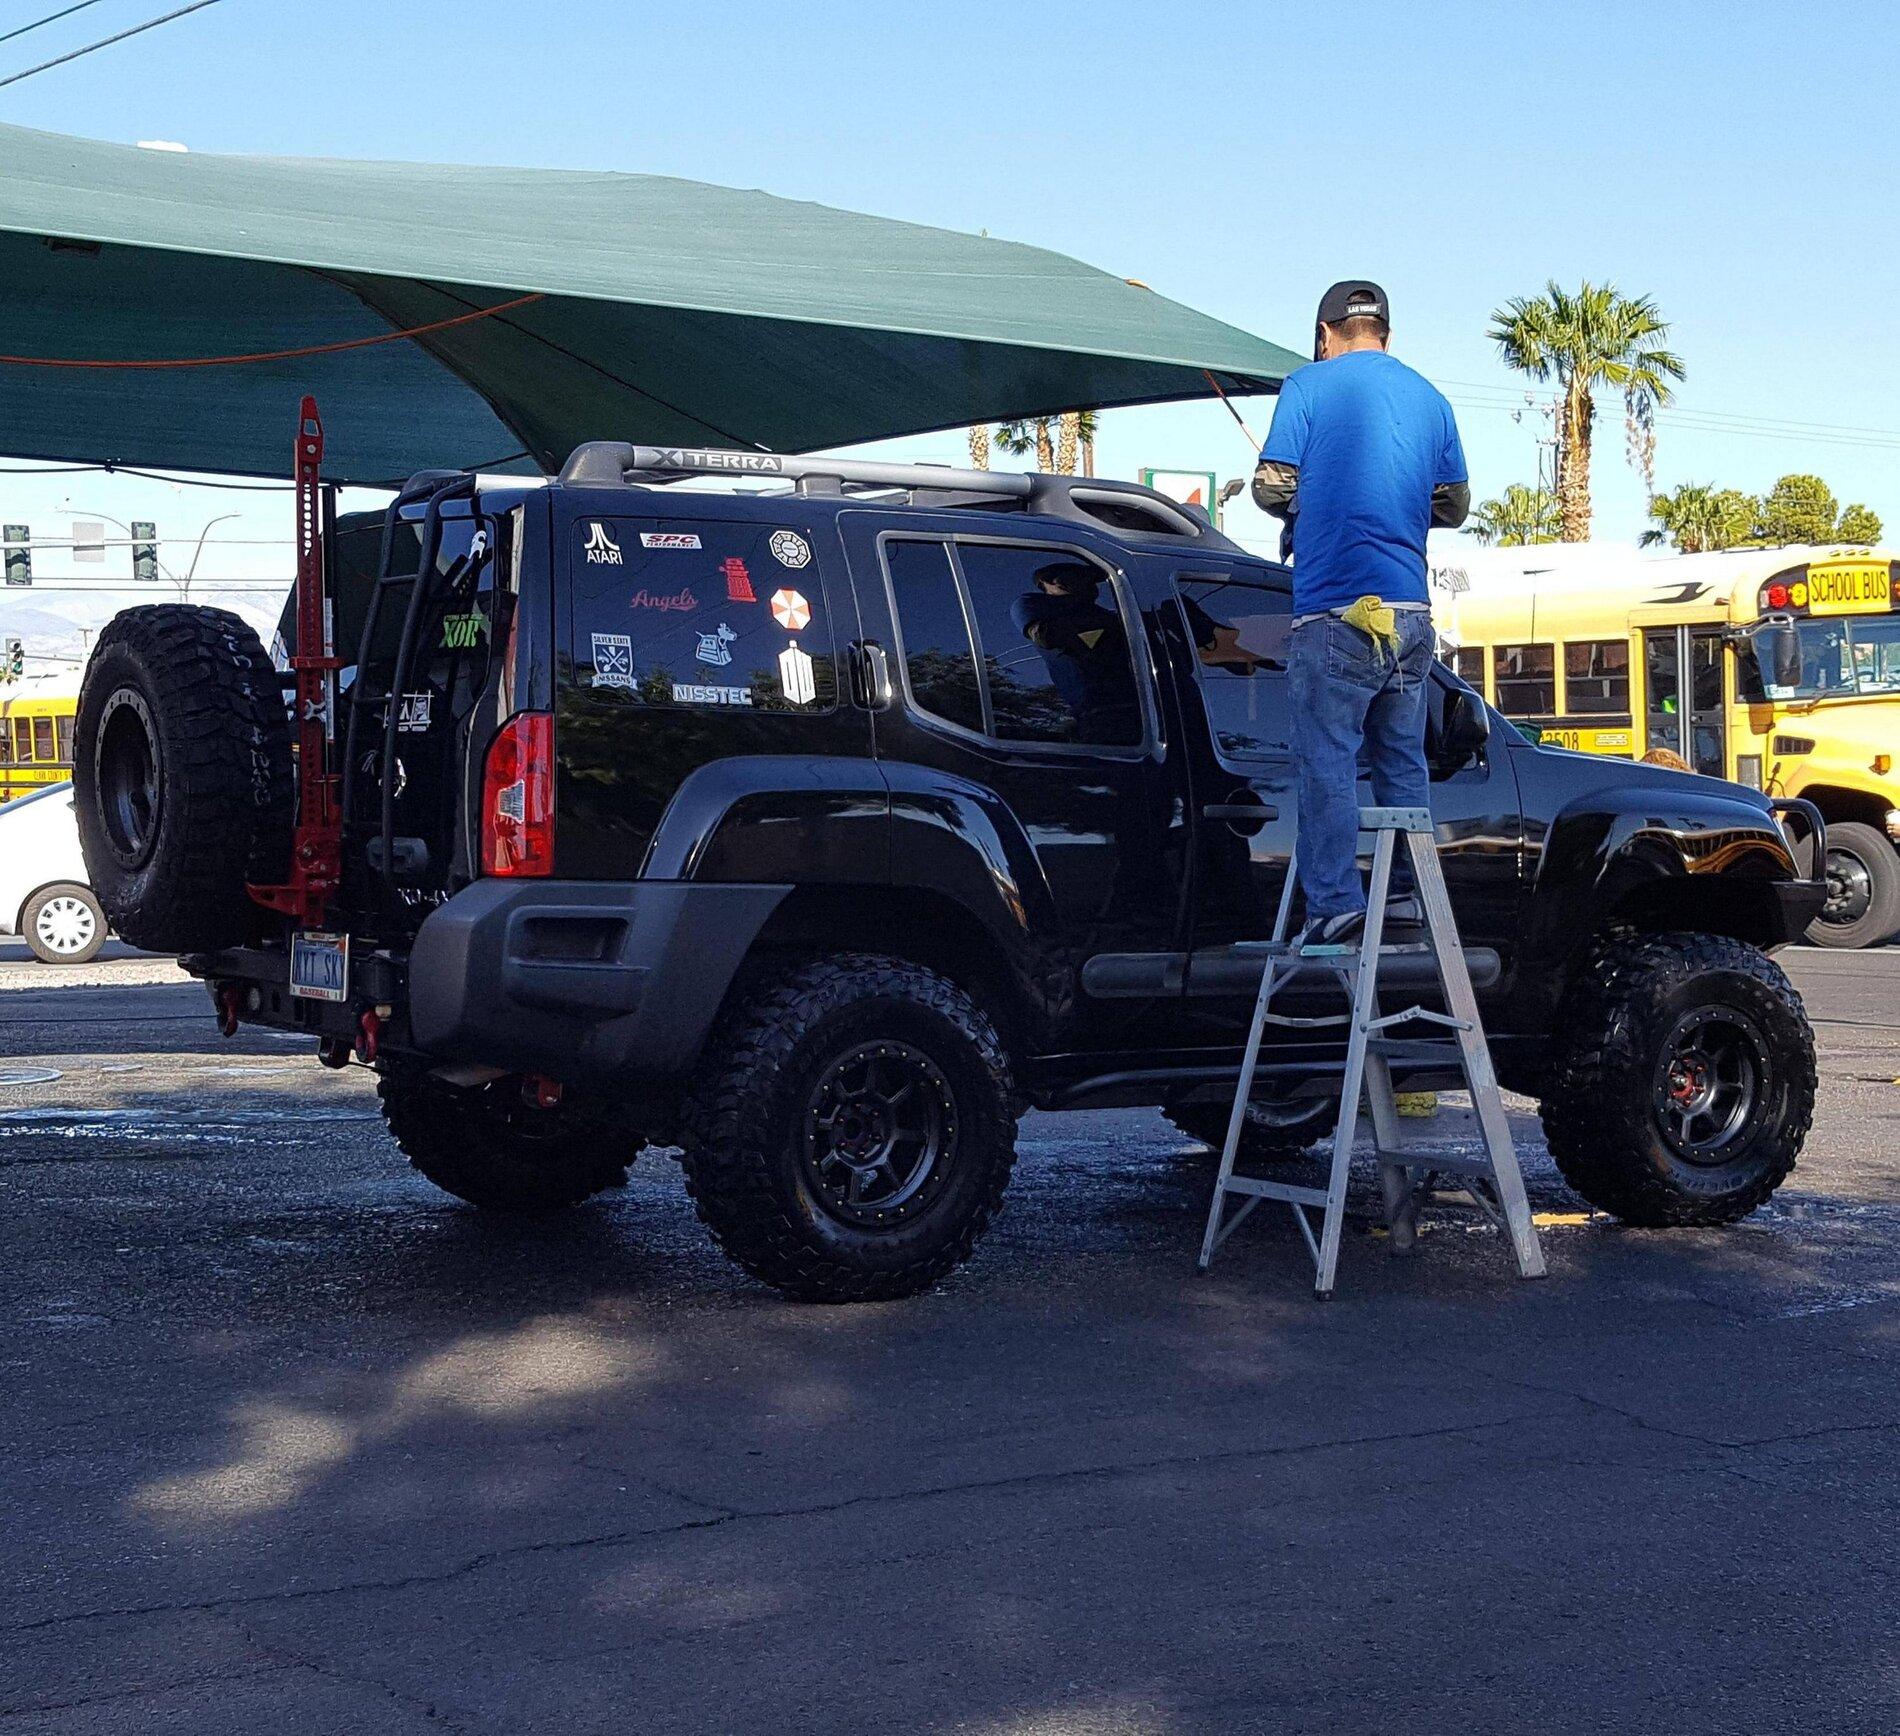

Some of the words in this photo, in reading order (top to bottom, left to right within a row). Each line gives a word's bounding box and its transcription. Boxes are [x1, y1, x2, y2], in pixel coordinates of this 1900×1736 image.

[1347, 305, 1359, 314] LAS
[1360, 305, 1378, 313] VEGAS
[652, 449, 783, 473] XTERRA
[647, 534, 697, 544] SPC
[586, 550, 623, 565] ATARI
[1810, 572, 1859, 602] SCHOOL
[1863, 571, 1887, 600] BUS
[630, 588, 699, 611] Angels
[673, 684, 752, 705] NISSTEC
